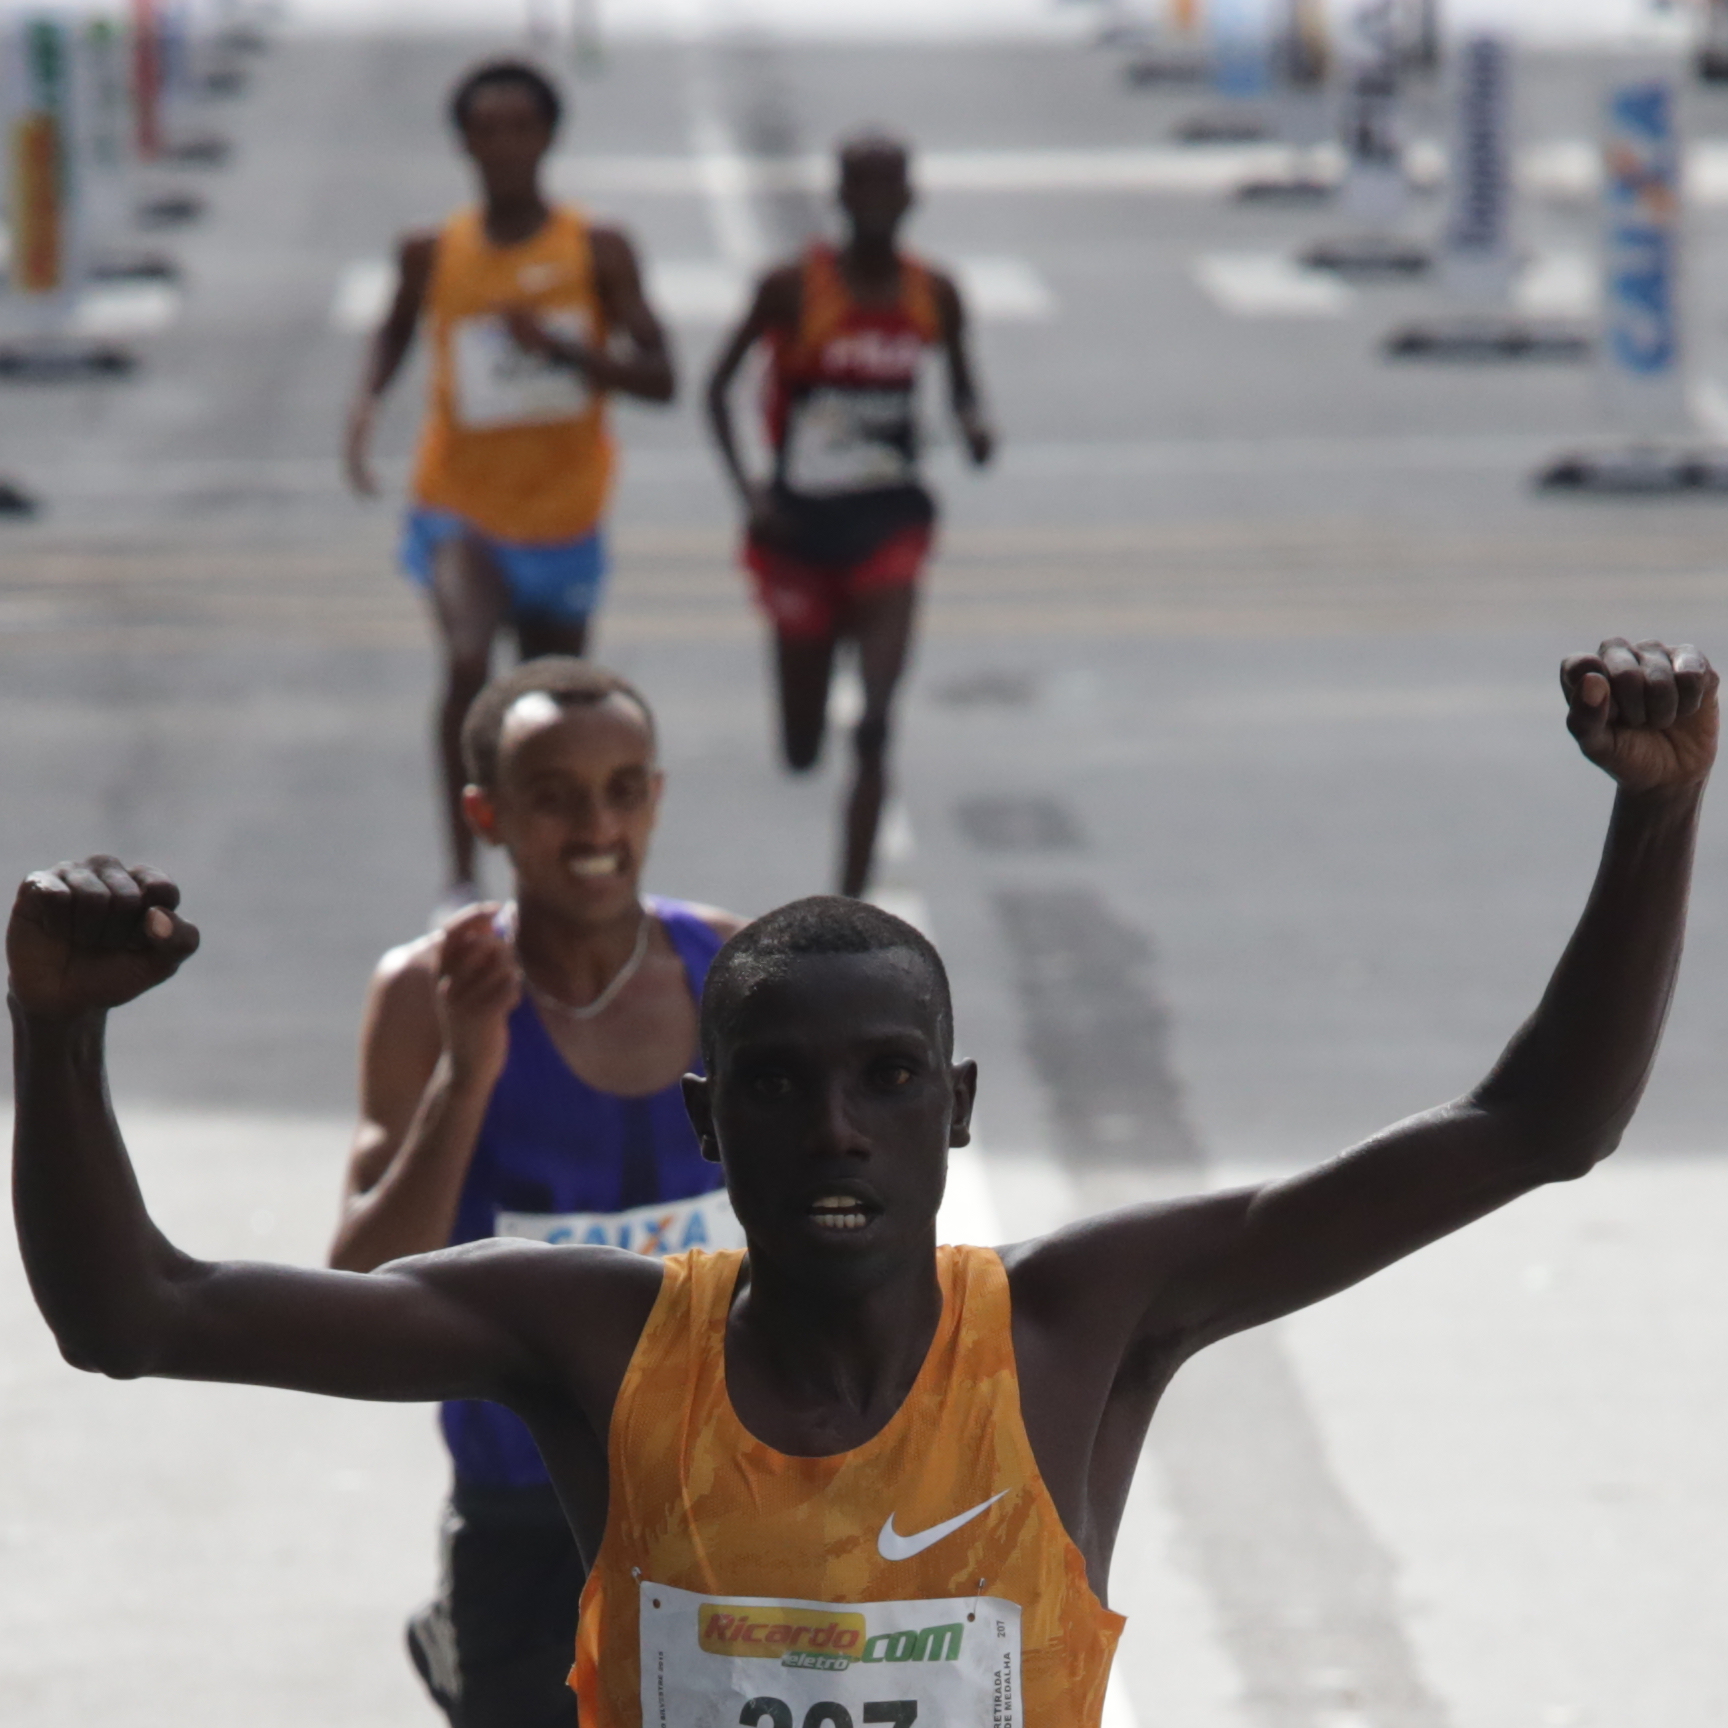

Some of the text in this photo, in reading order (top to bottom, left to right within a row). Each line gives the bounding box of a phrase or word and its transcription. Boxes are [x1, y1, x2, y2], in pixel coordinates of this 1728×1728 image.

[548, 1210, 708, 1256] CAIXA
[996, 1619, 1006, 1638] 207
[1003, 1652, 1012, 1711] MEDALHA
